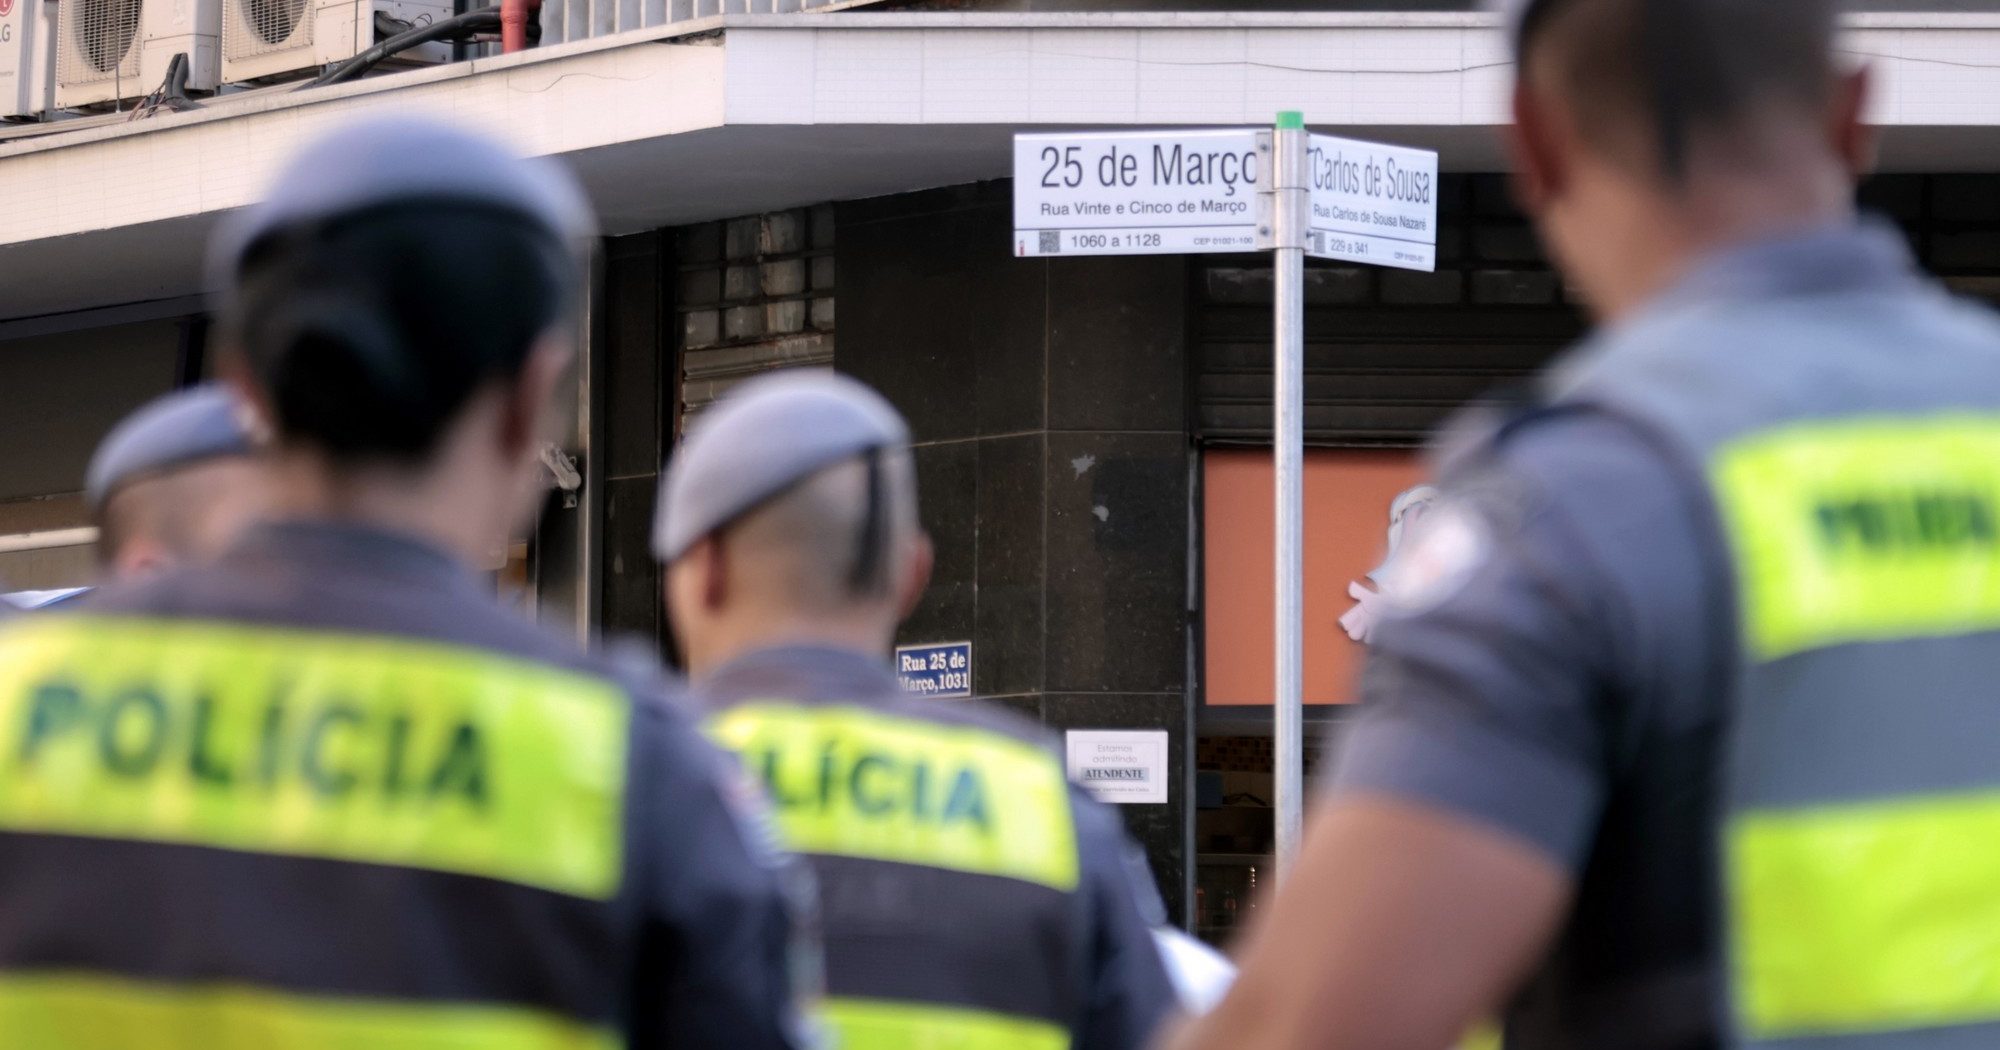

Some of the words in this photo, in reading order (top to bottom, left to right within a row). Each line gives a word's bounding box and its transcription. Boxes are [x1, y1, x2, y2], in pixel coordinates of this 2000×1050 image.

[1040, 146, 1083, 188] 25
[1099, 145, 1138, 187] de
[1152, 143, 1257, 196] Março
[1313, 147, 1359, 194] Carlos
[1364, 156, 1381, 197] de
[1387, 157, 1430, 204] Sousa
[1041, 203, 1069, 216] Rua
[1074, 202, 1111, 215] Vinte
[1116, 204, 1124, 214] e
[1130, 201, 1173, 214] Cinco
[1177, 200, 1196, 213] de
[1201, 199, 1247, 216] Março
[1314, 203, 1330, 218] Rua
[1333, 206, 1358, 221] Carlos
[1360, 211, 1370, 223] de
[1373, 211, 1398, 227] Sousa
[1399, 215, 1427, 231] Nazaré
[1071, 234, 1107, 248] 1060
[1112, 237, 1120, 247] a
[1127, 234, 1161, 247] 1128
[1193, 237, 1211, 245] CEP
[1330, 239, 1346, 252] 229
[1354, 242, 1369, 255] 341
[901, 655, 927, 672] Rua
[949, 651, 966, 668] de
[1097, 744, 1133, 753] Estamos
[1086, 769, 1144, 779] ATENDENTE
[760, 737, 990, 831] LÍCIA
